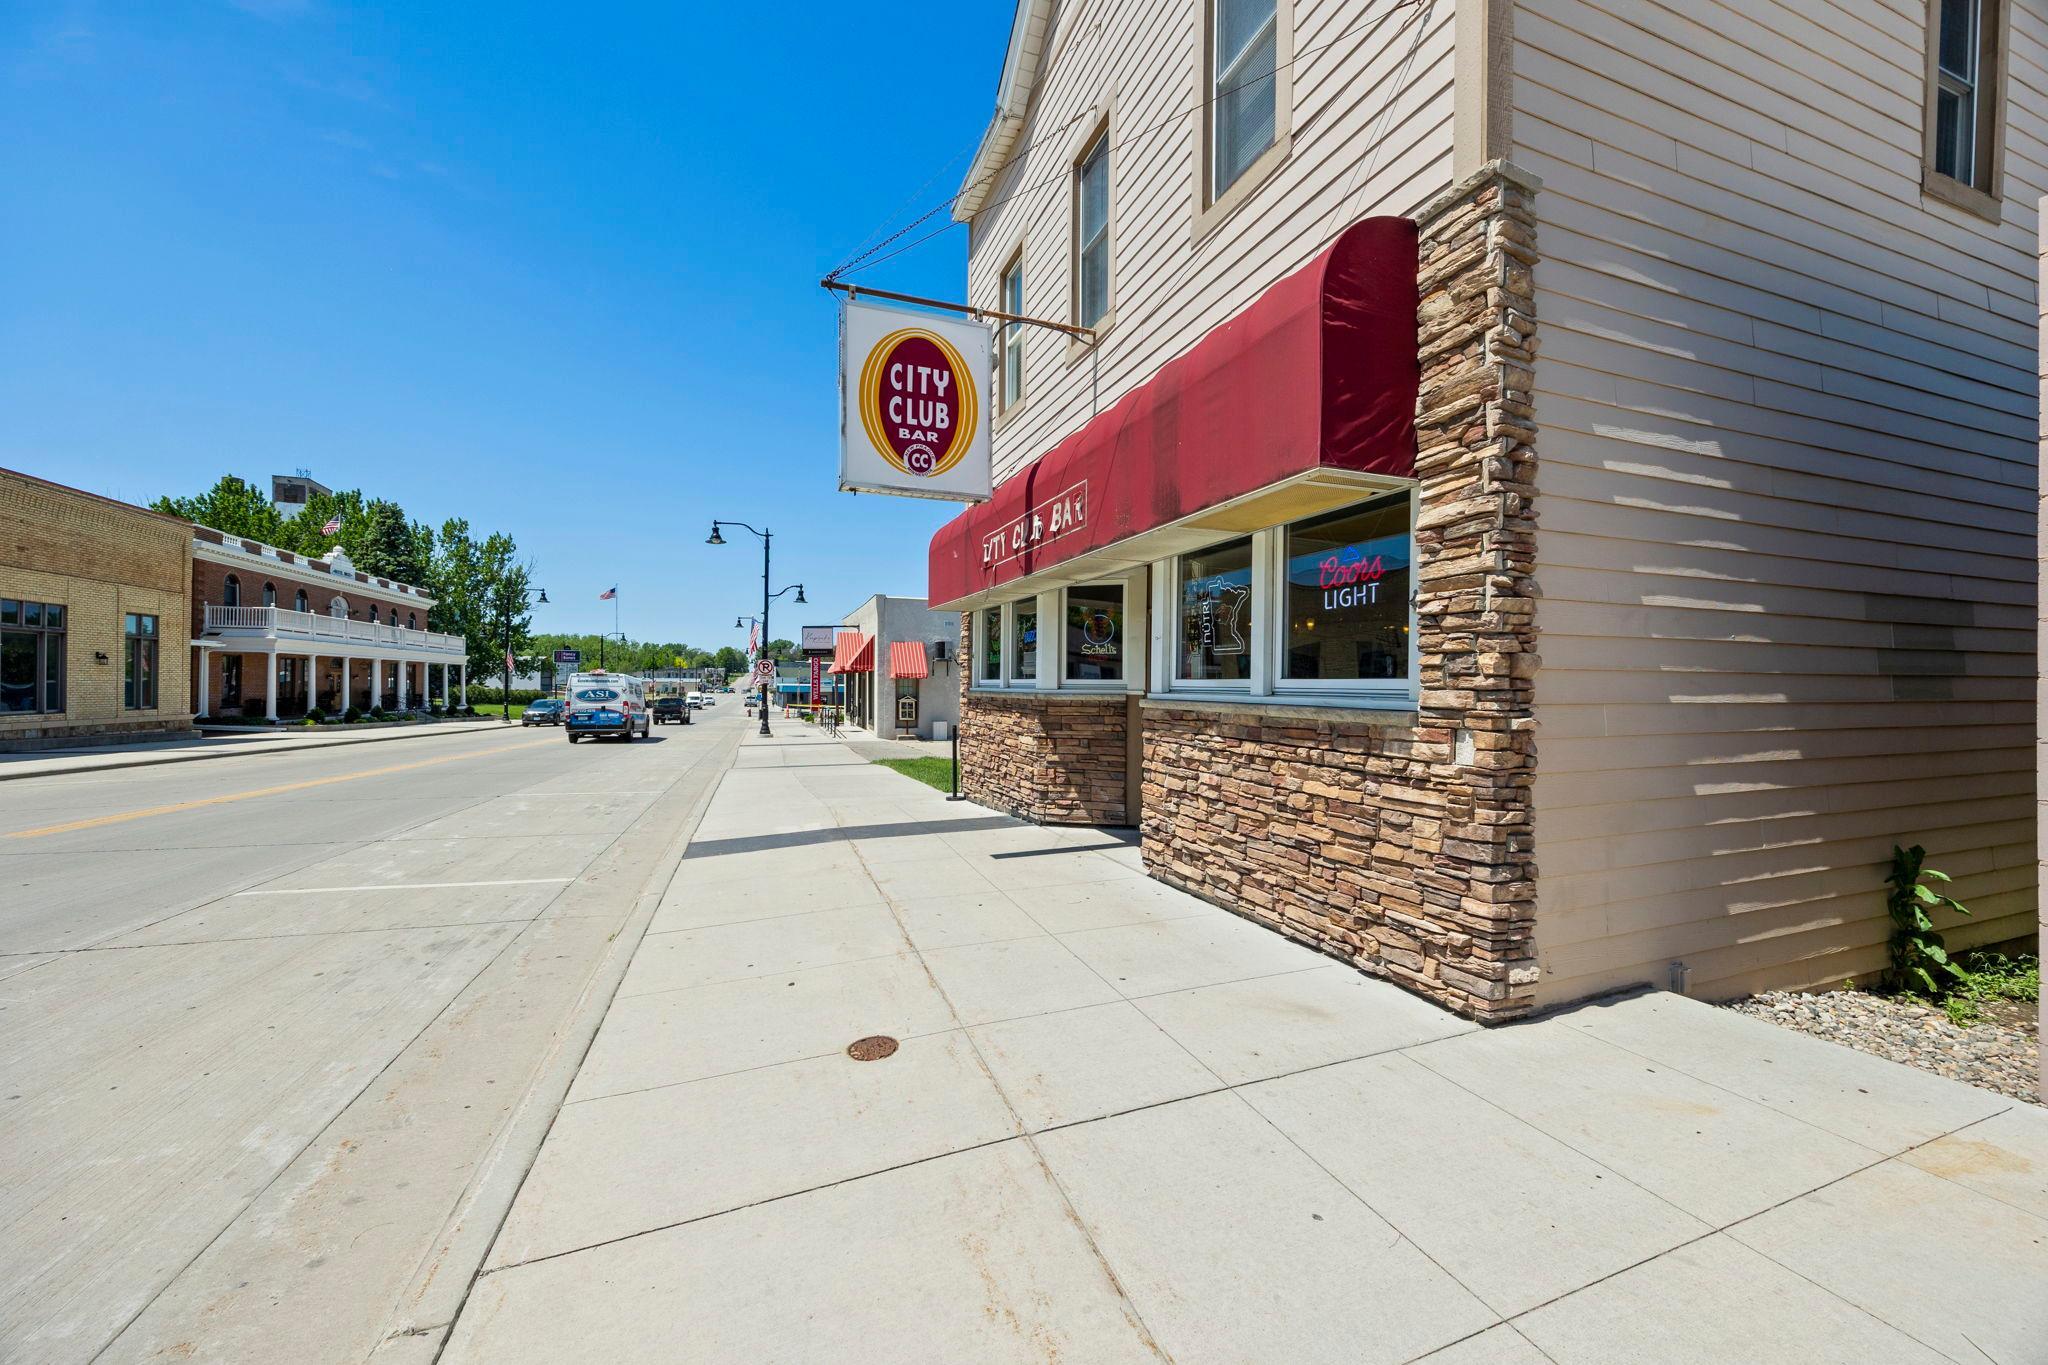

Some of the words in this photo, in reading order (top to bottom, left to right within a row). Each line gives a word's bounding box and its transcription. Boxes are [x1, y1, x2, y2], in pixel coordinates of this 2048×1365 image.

[890, 363, 950, 397] CITY
[889, 395, 950, 429] CLUB
[899, 428, 939, 443] BAR
[912, 453, 929, 469] CC
[1319, 555, 1386, 589] Coors
[1325, 582, 1380, 610] LIGHT
[584, 690, 609, 698] ASI
